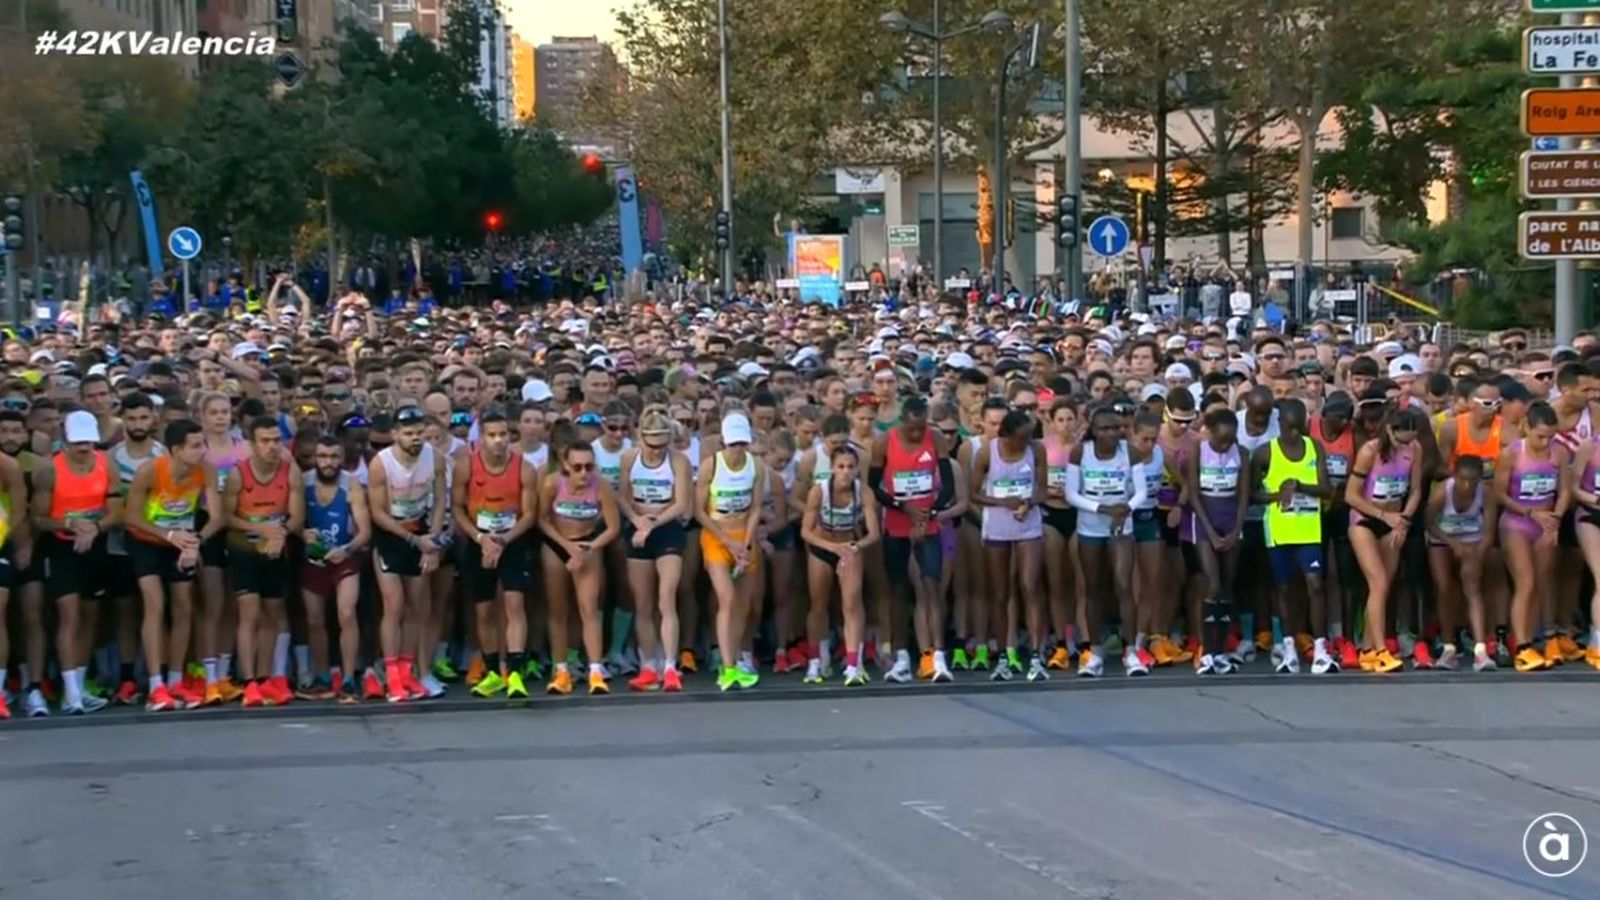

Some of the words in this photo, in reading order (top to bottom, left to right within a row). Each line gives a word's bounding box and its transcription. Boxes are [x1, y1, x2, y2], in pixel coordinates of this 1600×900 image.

[1533, 32, 1599, 47] hospital
[1533, 51, 1557, 69] La
[1573, 50, 1598, 68] Fe
[1532, 105, 1567, 120] Roig
[1530, 160, 1569, 170] CIUTAT
[1573, 160, 1589, 169] DE
[1538, 178, 1558, 188] LES
[1530, 221, 1568, 235] parc
[1529, 239, 1550, 253] de
